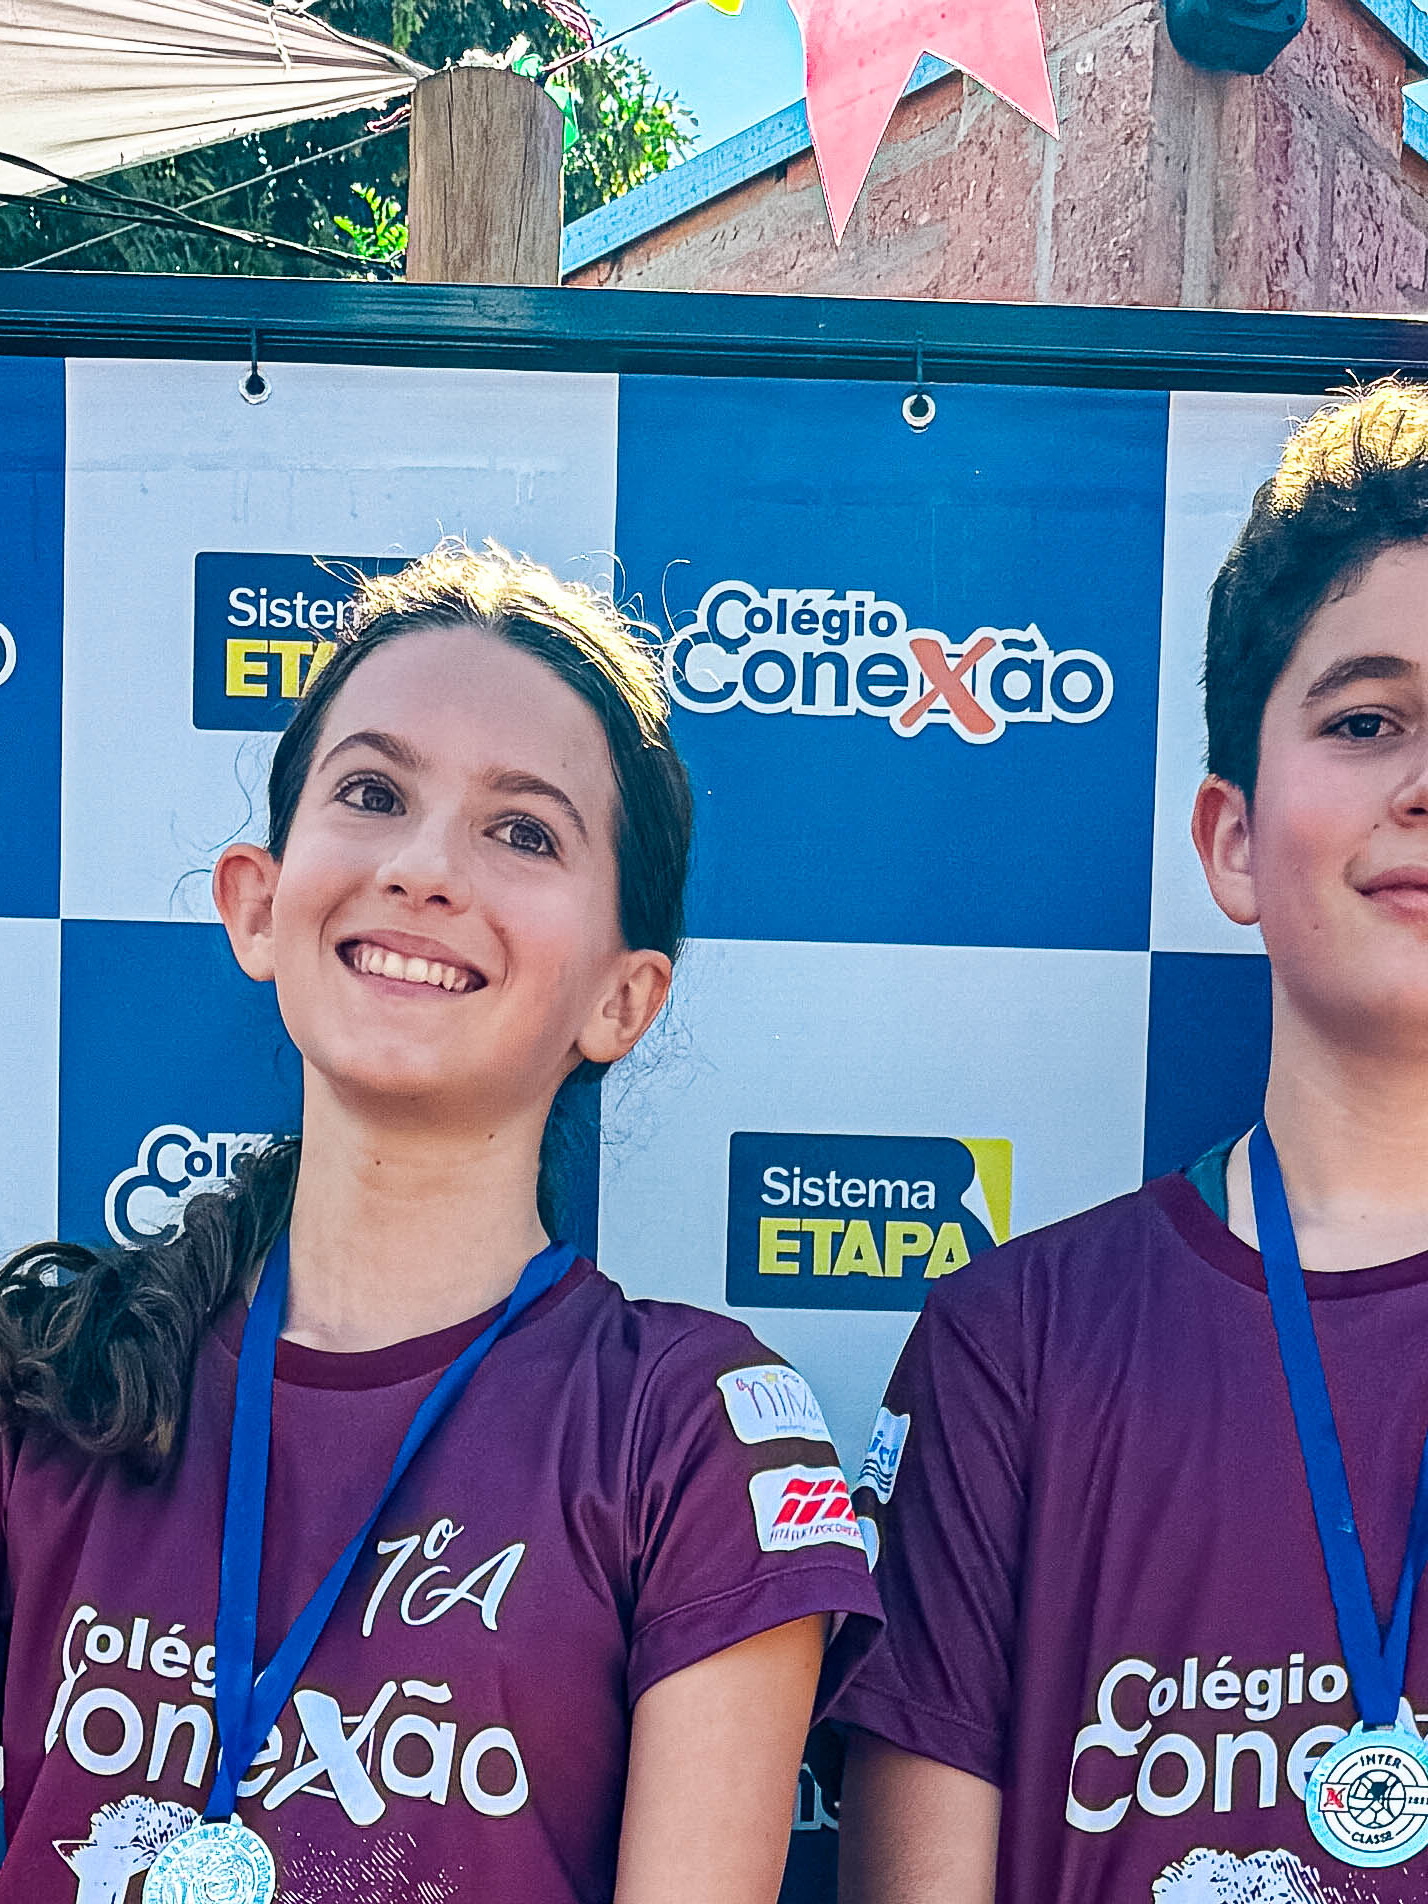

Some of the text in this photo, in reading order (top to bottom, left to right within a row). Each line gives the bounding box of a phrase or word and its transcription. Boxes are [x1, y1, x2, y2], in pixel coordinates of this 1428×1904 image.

[707, 589, 898, 646] Colégio
[760, 1166, 936, 1210] Sistema
[758, 1217, 970, 1280] ETAPA
[1097, 1652, 1348, 1728] Colégio
